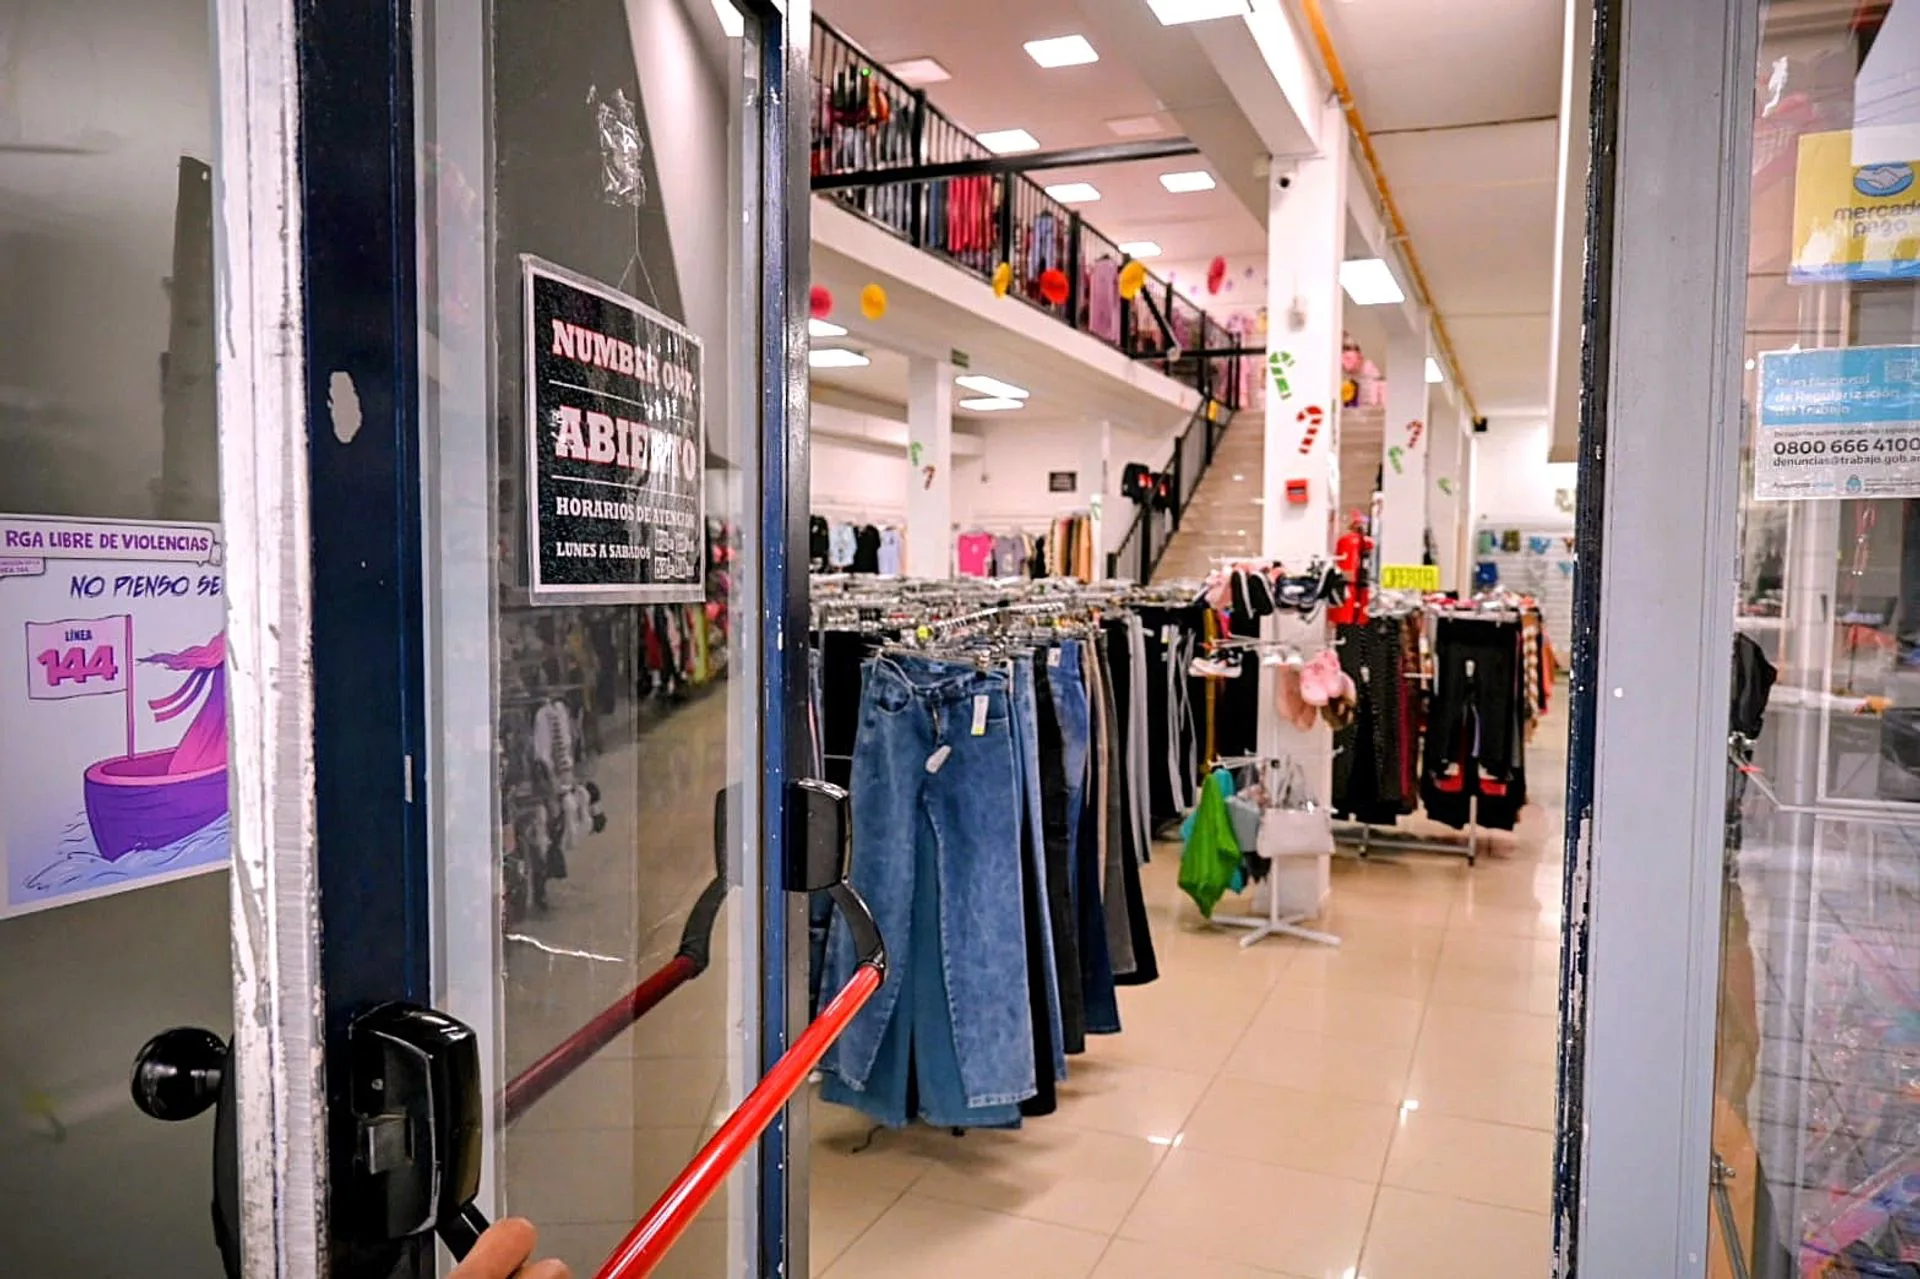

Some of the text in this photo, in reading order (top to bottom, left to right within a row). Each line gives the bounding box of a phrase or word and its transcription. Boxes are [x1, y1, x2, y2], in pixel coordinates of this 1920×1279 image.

[1834, 200, 1920, 221] mercad
[1773, 437, 1920, 456] 0800 666 4100
[556, 496, 635, 521] HORARIOS
[636, 504, 651, 523] DE
[49, 531, 94, 549] LIBRE
[99, 533, 118, 549] DE
[122, 534, 209, 551] VIOLENCIAS
[556, 541, 651, 559] LUNES A SABADOS
[70, 574, 223, 598] NO PIENSO SE
[64, 629, 92, 642] LÍNEA
[37, 645, 119, 687] 144
